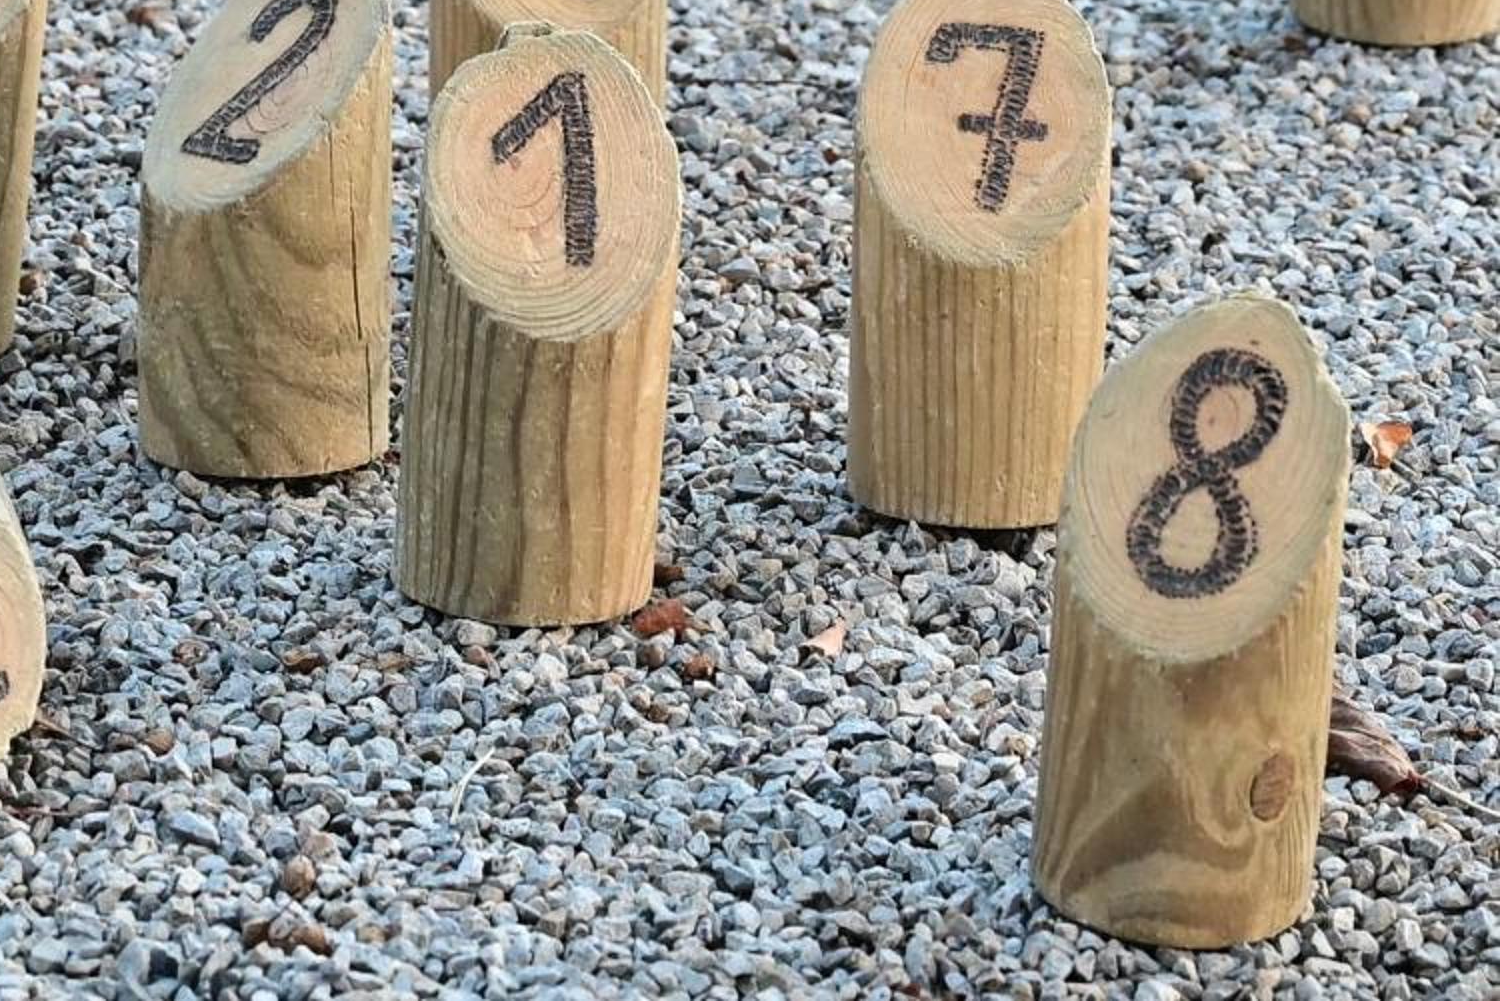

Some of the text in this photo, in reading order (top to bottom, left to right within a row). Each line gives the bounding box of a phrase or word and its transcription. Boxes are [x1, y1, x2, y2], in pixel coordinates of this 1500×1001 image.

[490, 71, 598, 267] 1
[925, 22, 1048, 214] 7
[1126, 348, 1288, 599] 8
